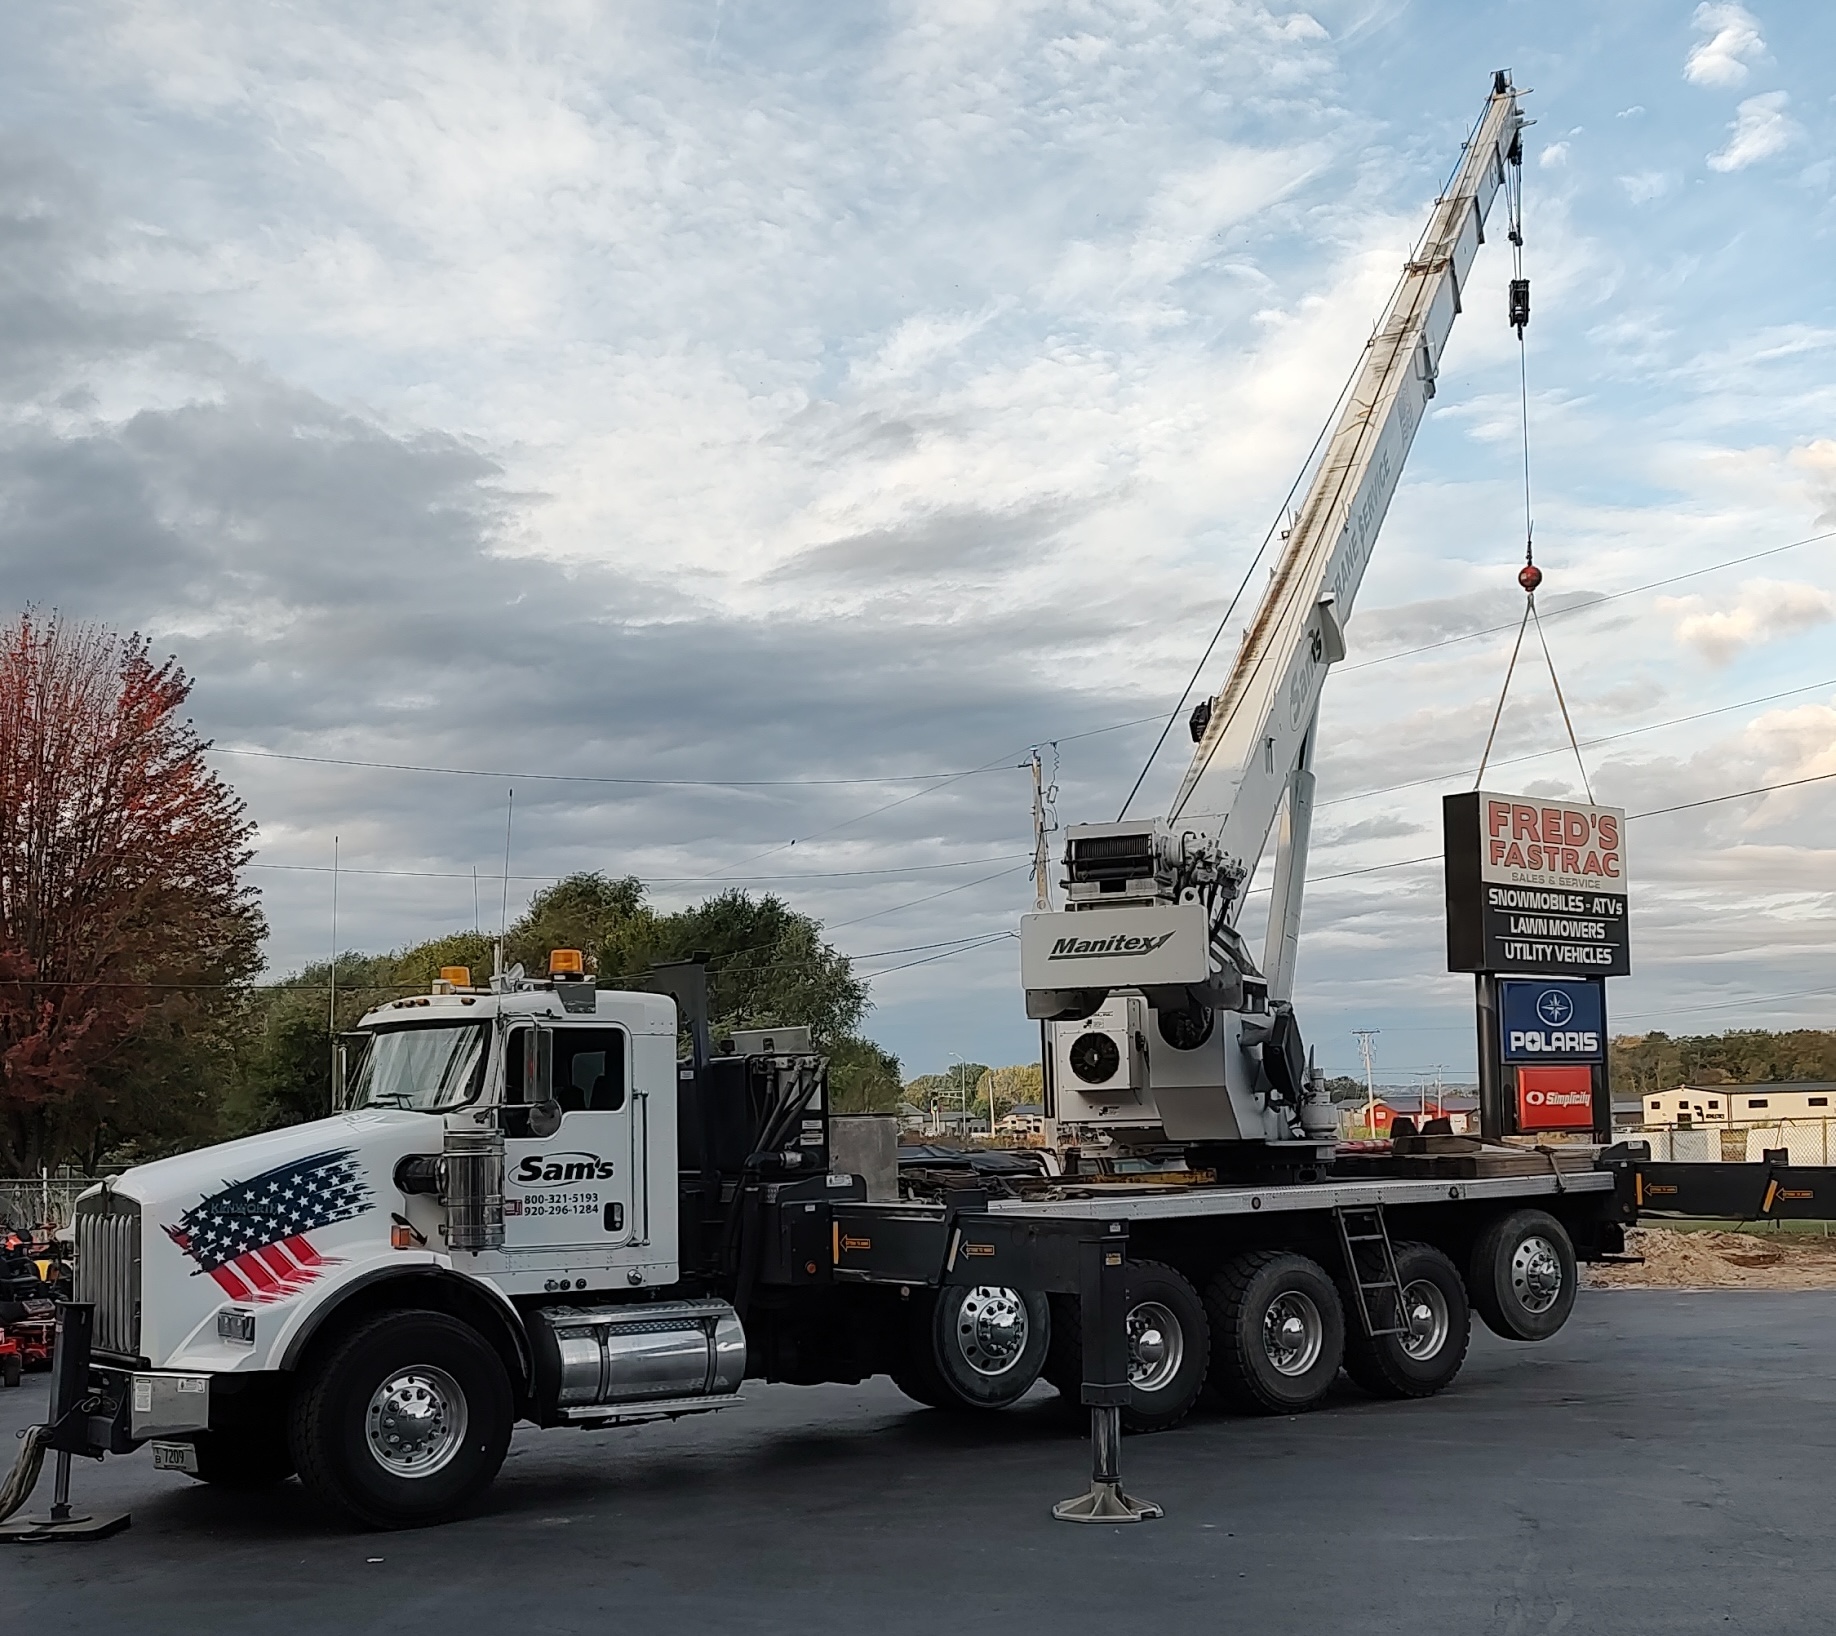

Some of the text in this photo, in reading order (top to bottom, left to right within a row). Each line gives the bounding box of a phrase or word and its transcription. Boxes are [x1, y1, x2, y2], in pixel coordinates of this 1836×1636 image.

[1331, 448, 1391, 602] RANE SERVICE
[1488, 801, 1619, 850] FRED'S
[1489, 839, 1620, 878] FASTRAC
[1511, 872, 1601, 889] SALES & SERVICE
[1488, 888, 1585, 912] SNOWMOBILES
[1592, 897, 1623, 915] ATVs
[1510, 916, 1606, 939] LAWN MOWERS
[1050, 934, 1161, 955] Manitex
[1504, 942, 1613, 965] UTILITY VEHICLES
[1510, 1031, 1598, 1052] POLARIS
[1545, 1090, 1592, 1108] Simplicity
[518, 1155, 614, 1182] Sam's
[524, 1193, 599, 1204] 800-321-5193
[524, 1204, 599, 1216] 920-296-1284
[163, 1449, 185, 1464] 7209
